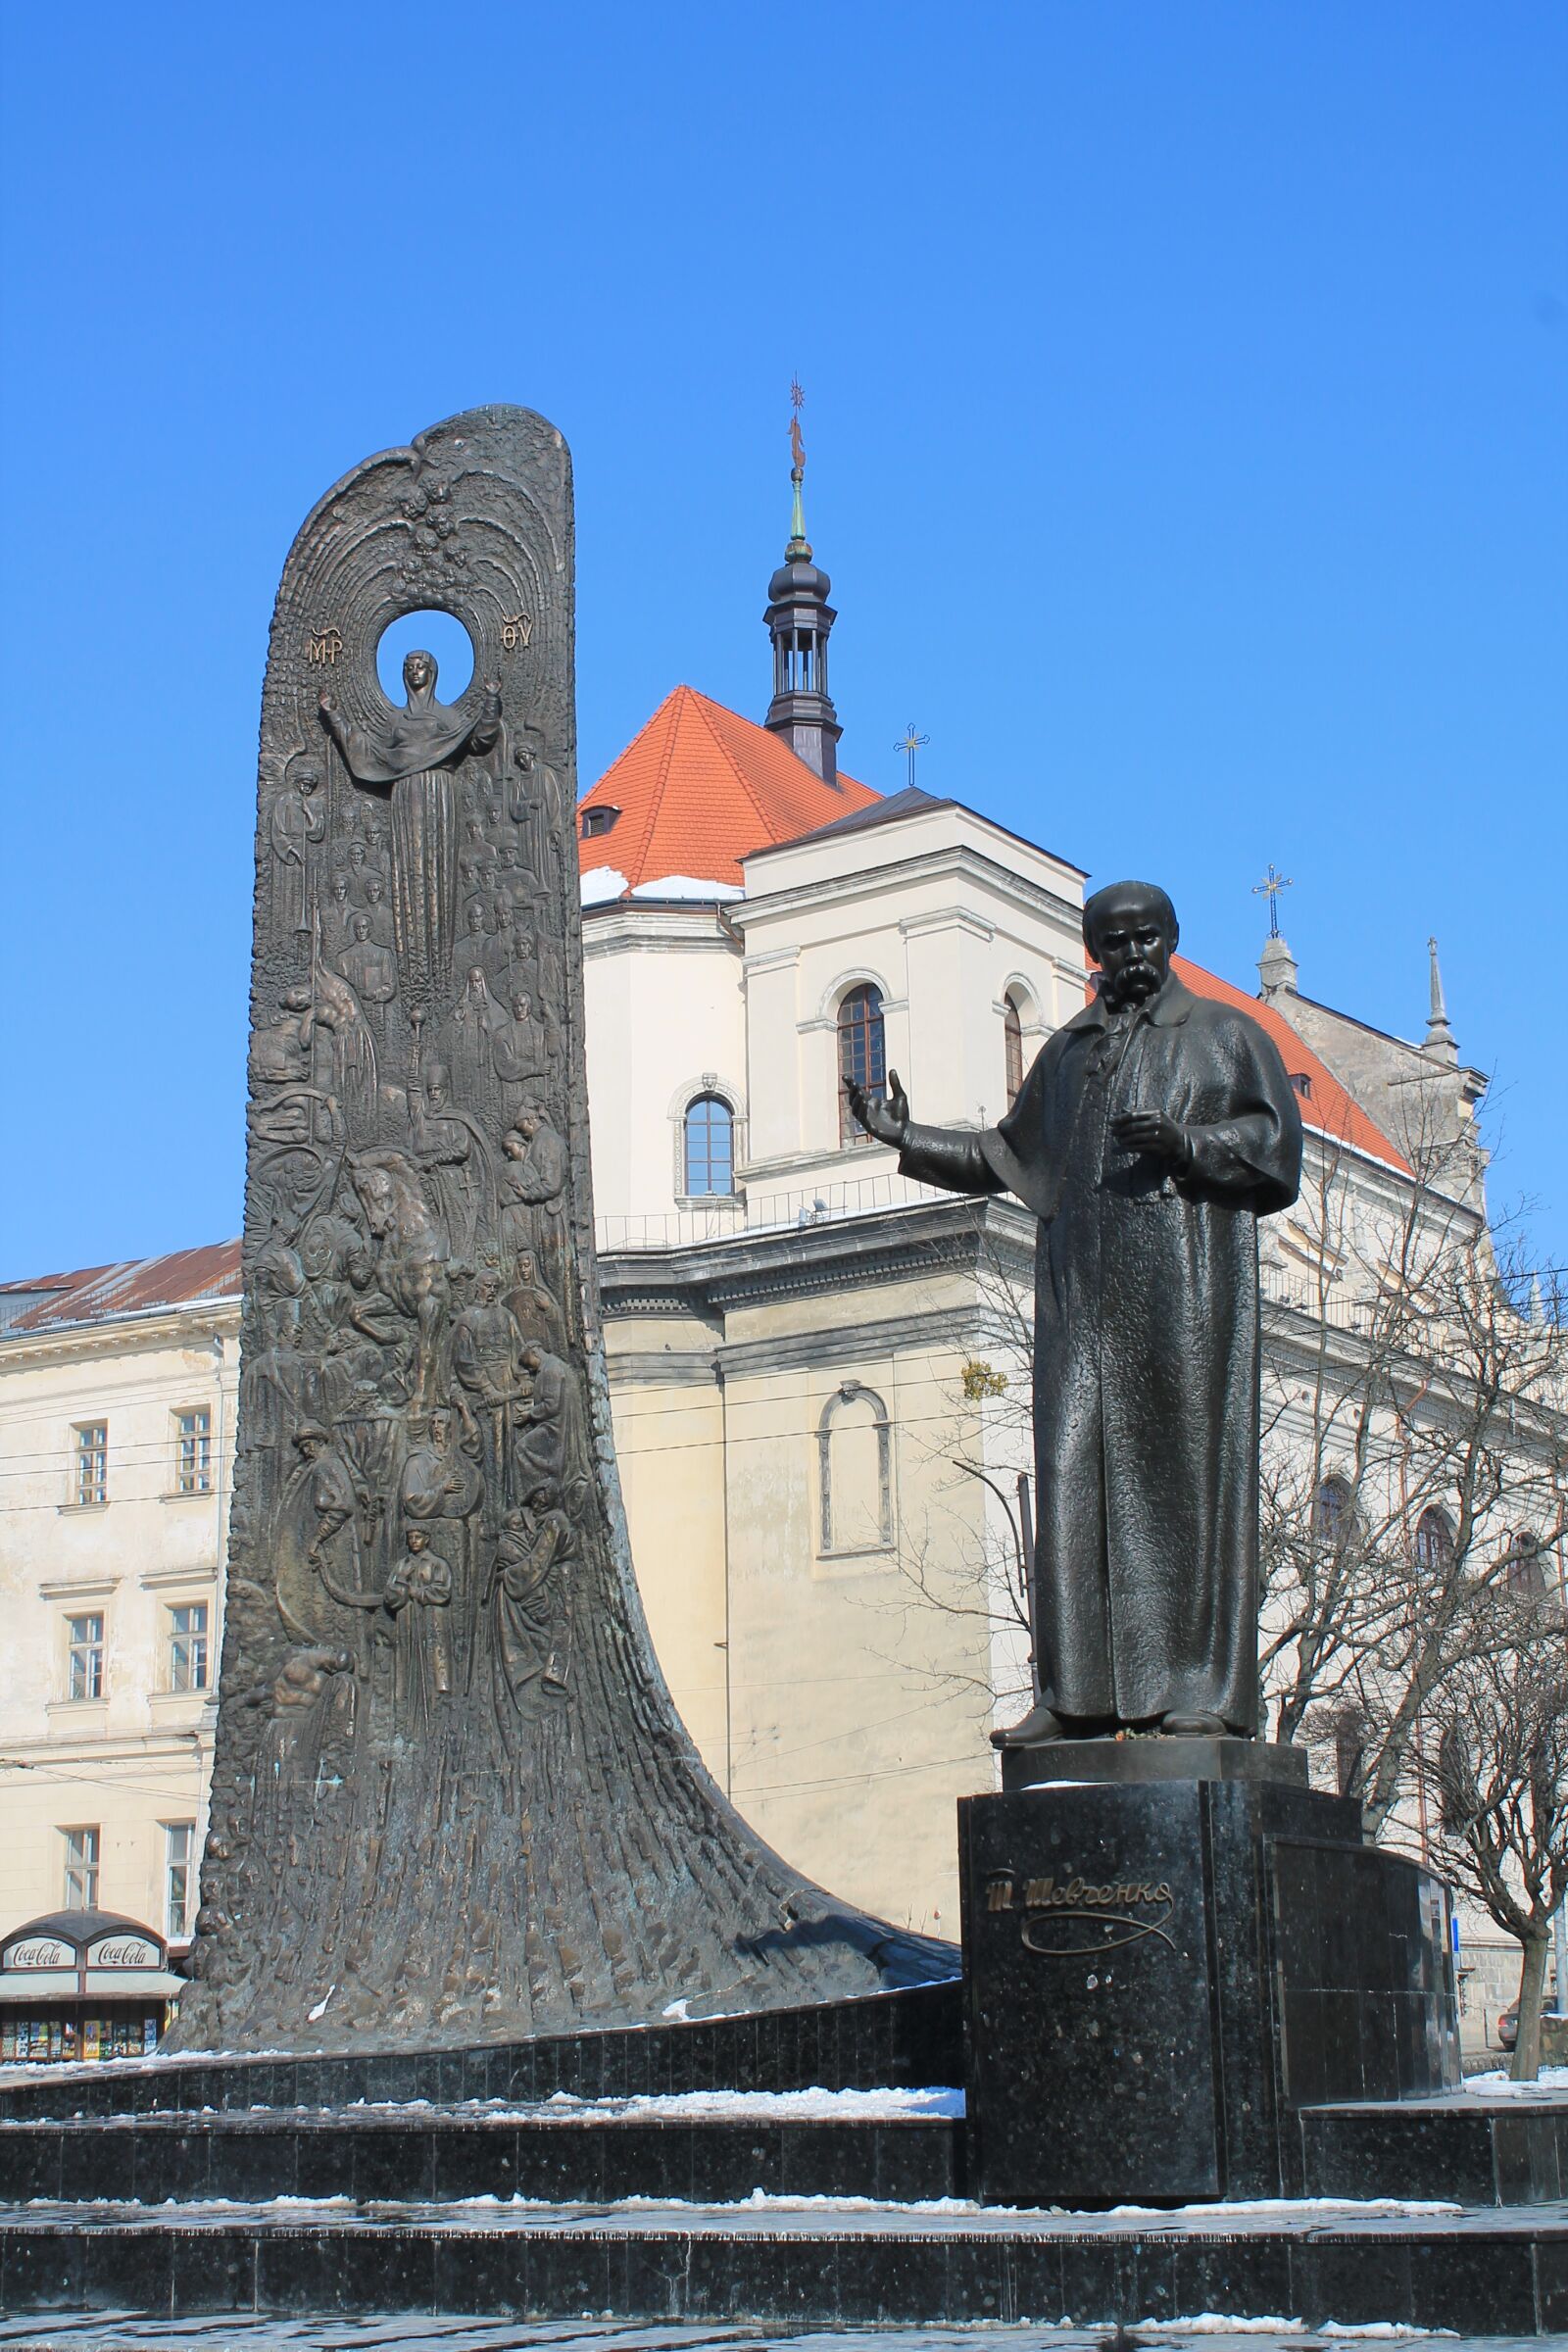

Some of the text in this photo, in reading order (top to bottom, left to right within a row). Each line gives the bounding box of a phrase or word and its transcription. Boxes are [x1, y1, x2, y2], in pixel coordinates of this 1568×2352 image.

[1022, 1877, 1174, 1907] Шевченко
[14, 1941, 63, 1966] Coca-Cola
[98, 1941, 148, 1965] Coca-Cola
